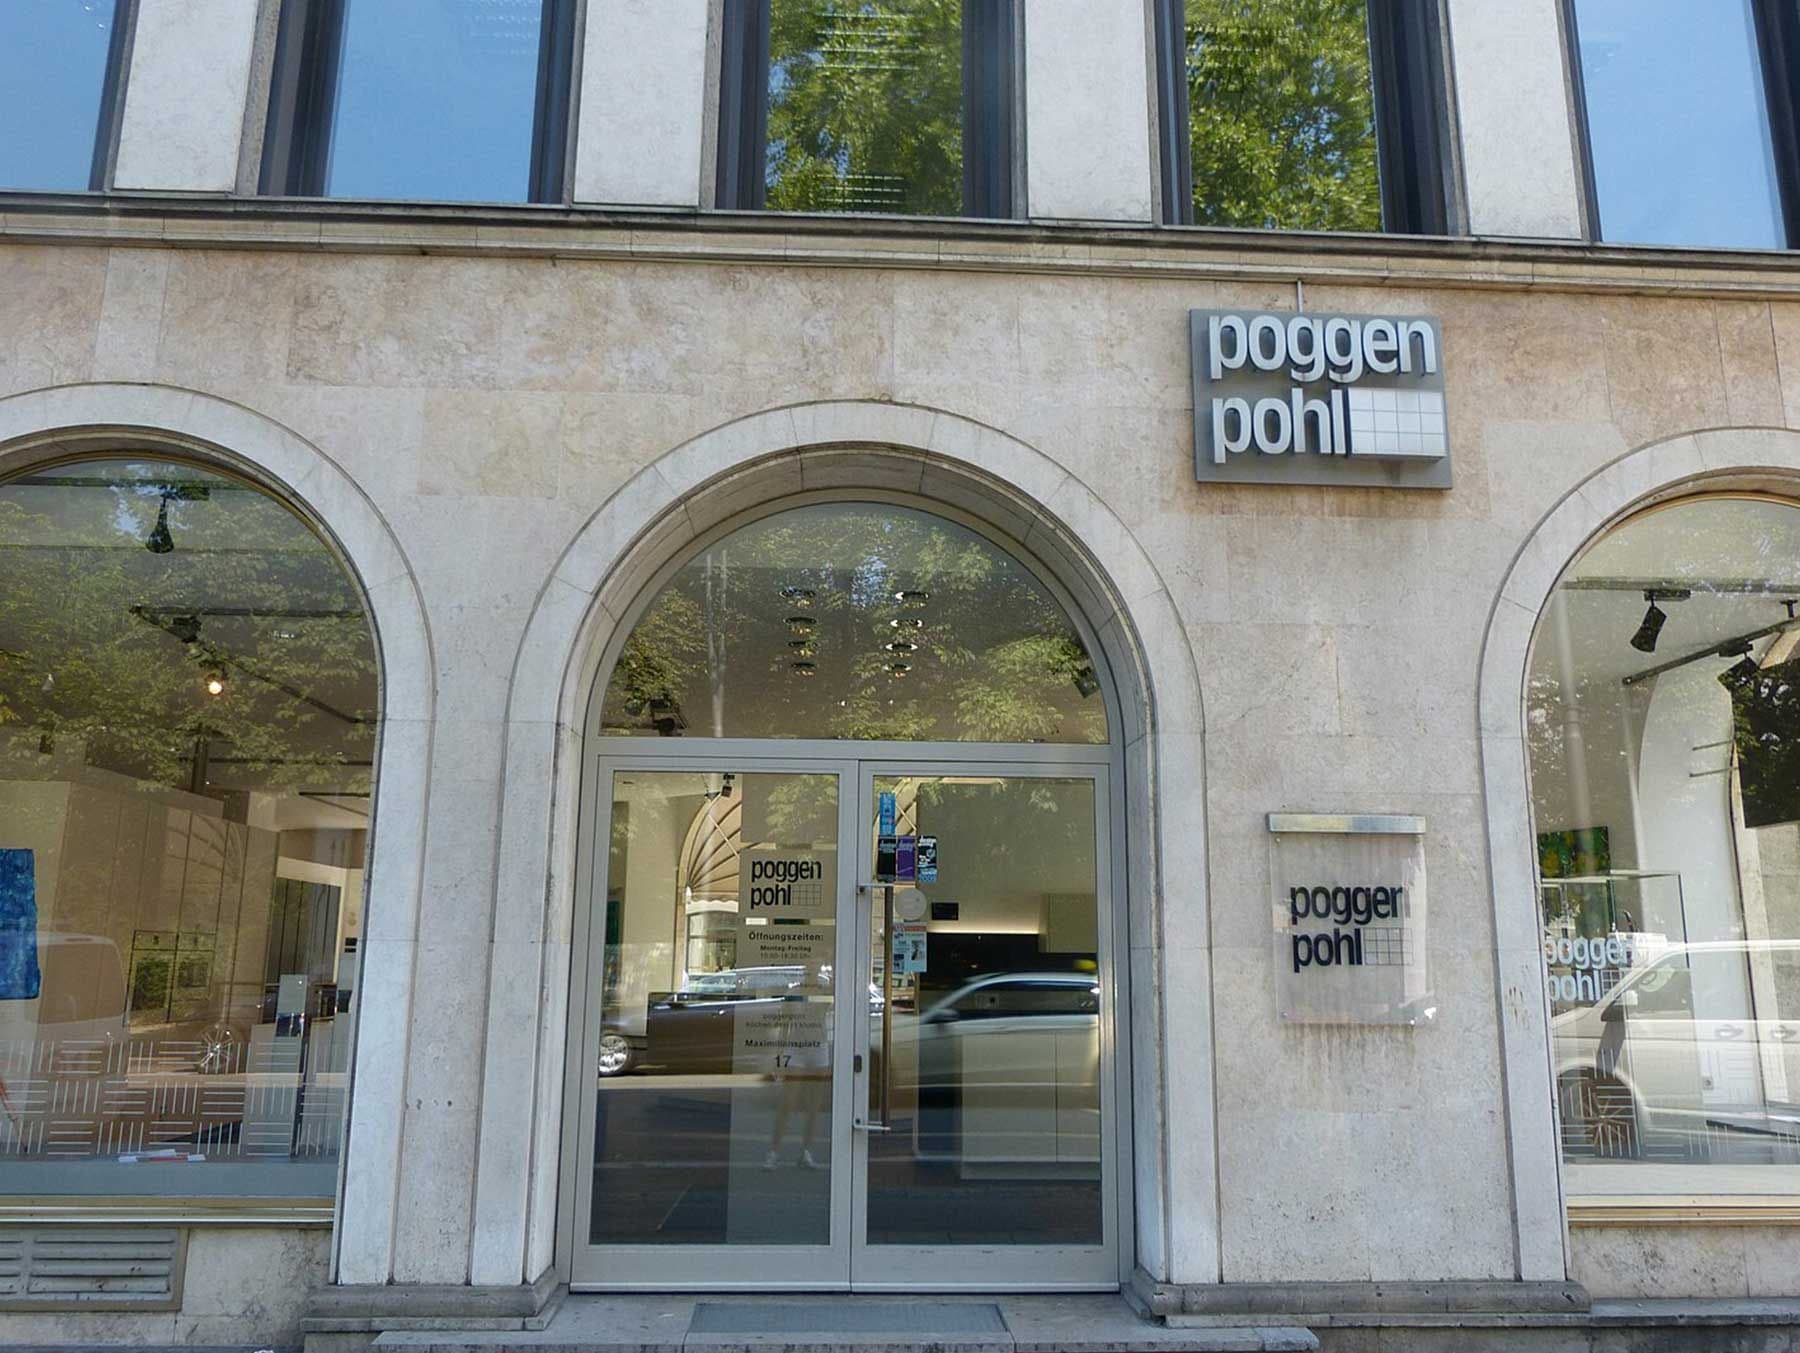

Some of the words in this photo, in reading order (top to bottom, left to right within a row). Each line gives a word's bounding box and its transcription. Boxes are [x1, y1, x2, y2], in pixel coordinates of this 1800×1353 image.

[1208, 314, 1437, 384] poggen
[1212, 387, 1347, 464] pohl
[751, 860, 822, 883] poggen
[750, 884, 791, 910] pohl
[1292, 928, 1363, 973] pohl
[775, 1055, 792, 1068] 17
